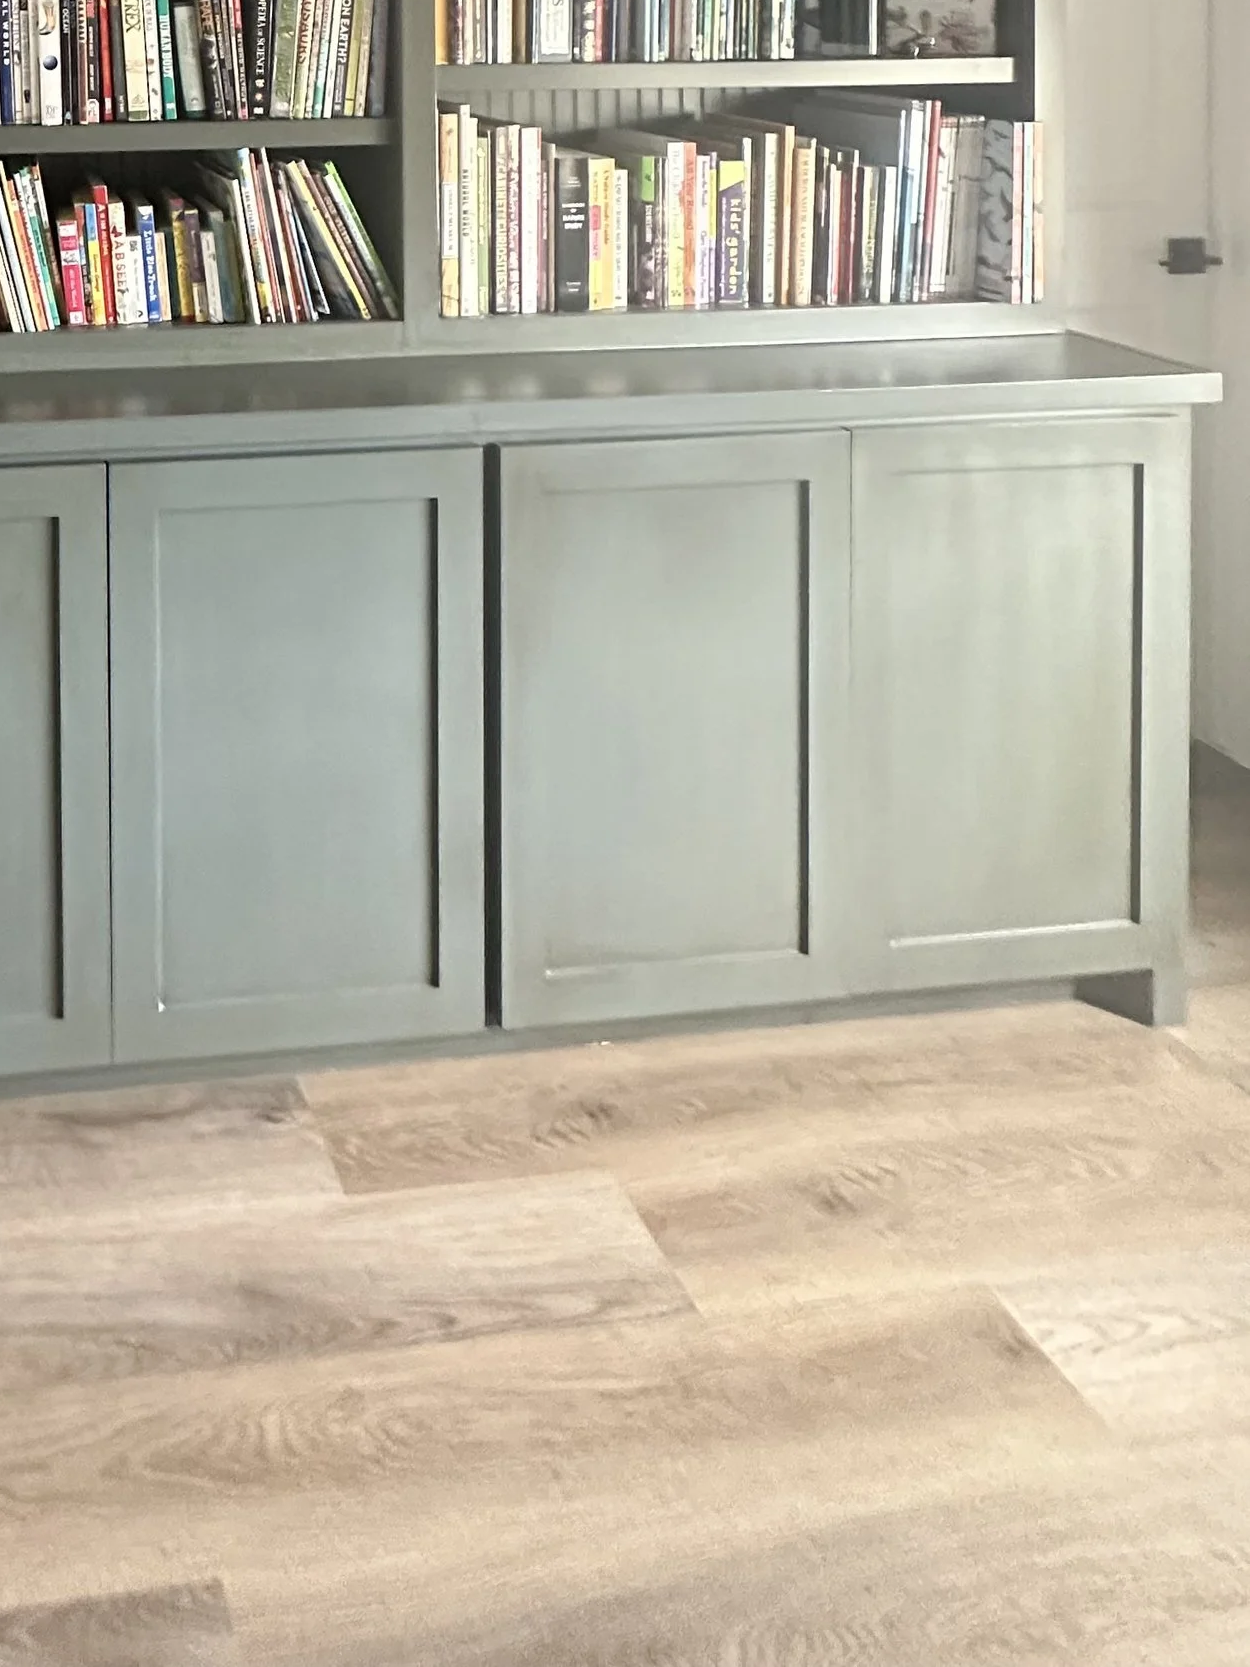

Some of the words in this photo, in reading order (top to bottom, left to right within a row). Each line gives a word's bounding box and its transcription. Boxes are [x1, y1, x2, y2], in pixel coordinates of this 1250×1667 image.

[62, 8, 70, 33] OCEAN
[159, 14, 171, 51] HUMAN
[2, 20, 11, 66] WORLD
[337, 18, 350, 64] EARTH?
[162, 52, 173, 78] BODY
[255, 37, 266, 75] SCIENCE
[461, 169, 470, 206] NATURAL
[461, 210, 470, 237] WORLD
[729, 197, 743, 234] kids'
[114, 240, 124, 249] A
[143, 230, 153, 254] Little
[115, 252, 125, 261] B
[146, 255, 154, 273] Blue
[726, 236, 743, 294] garden
[147, 274, 157, 301] Truck
